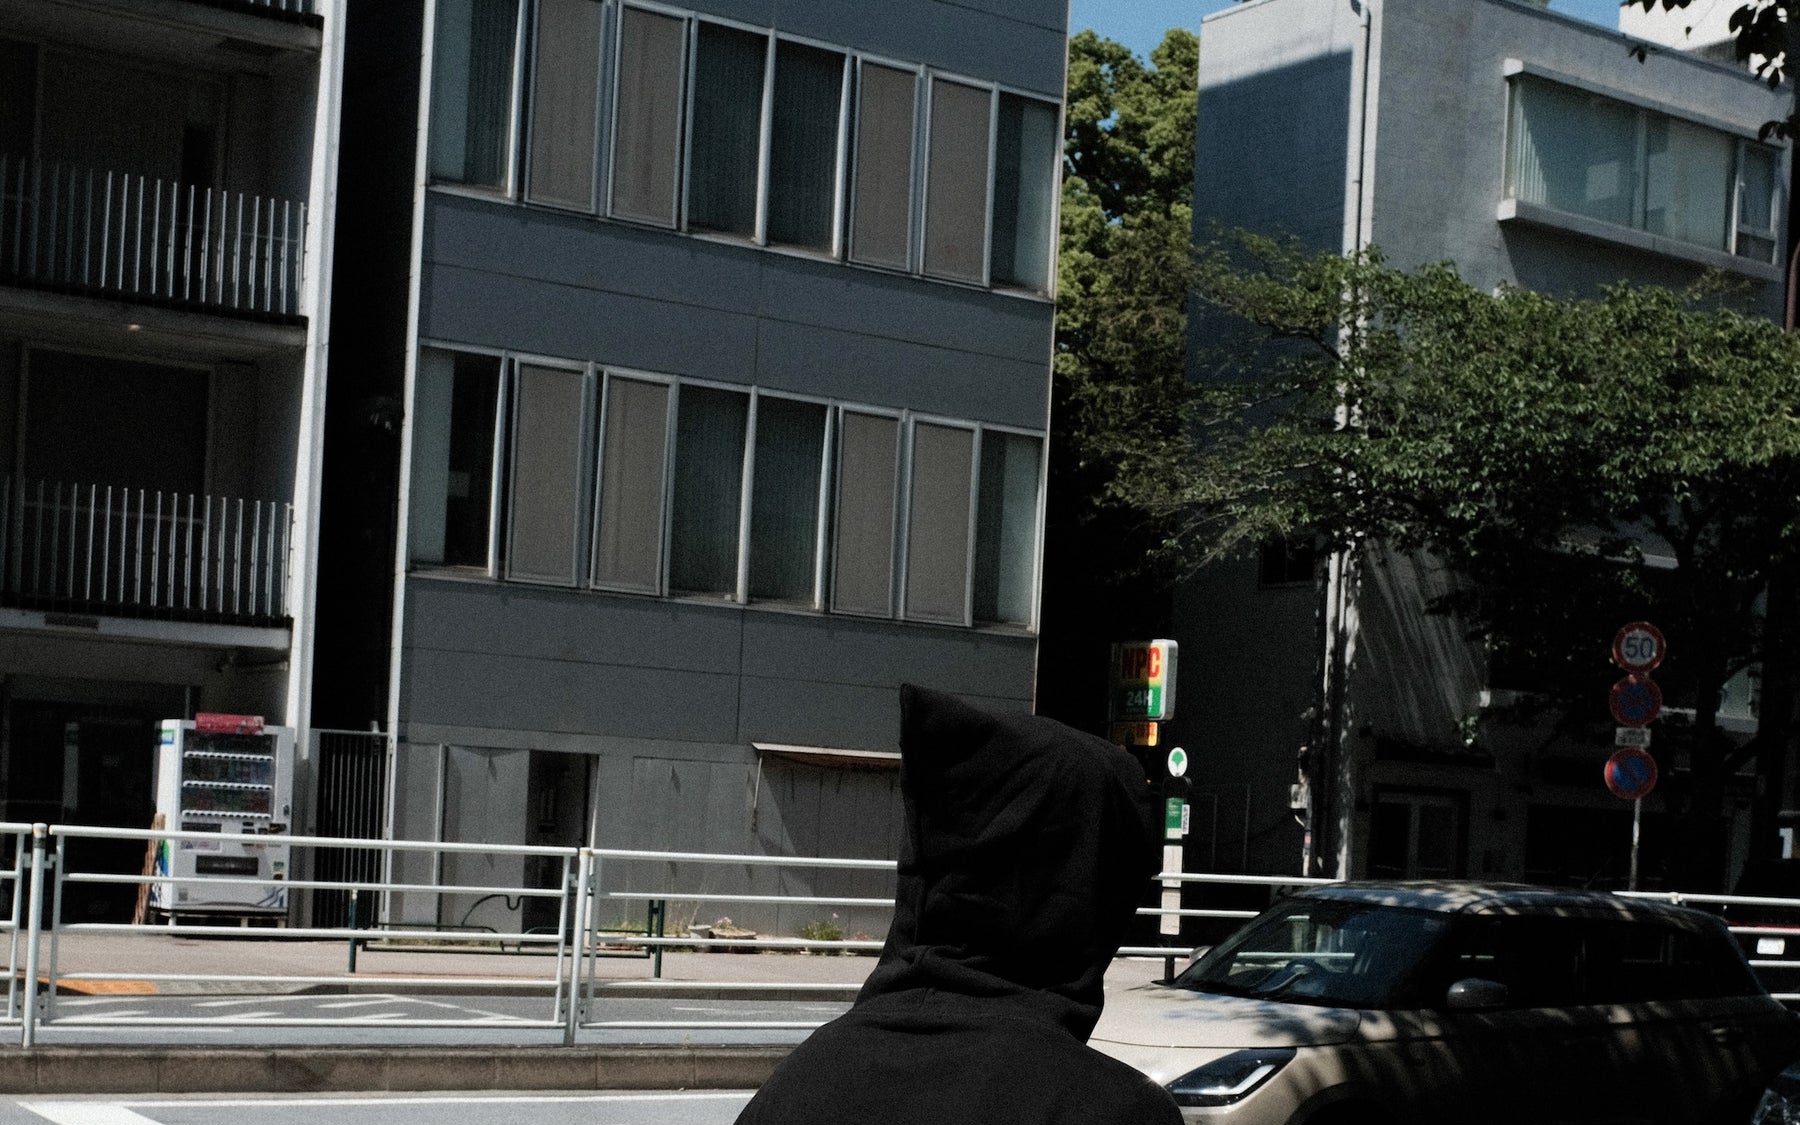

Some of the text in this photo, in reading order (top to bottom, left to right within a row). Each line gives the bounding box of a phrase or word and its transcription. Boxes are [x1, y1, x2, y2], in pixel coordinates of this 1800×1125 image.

[1625, 636, 1654, 659] 50
[1121, 646, 1160, 679] NPC
[1126, 688, 1154, 707] 24H
